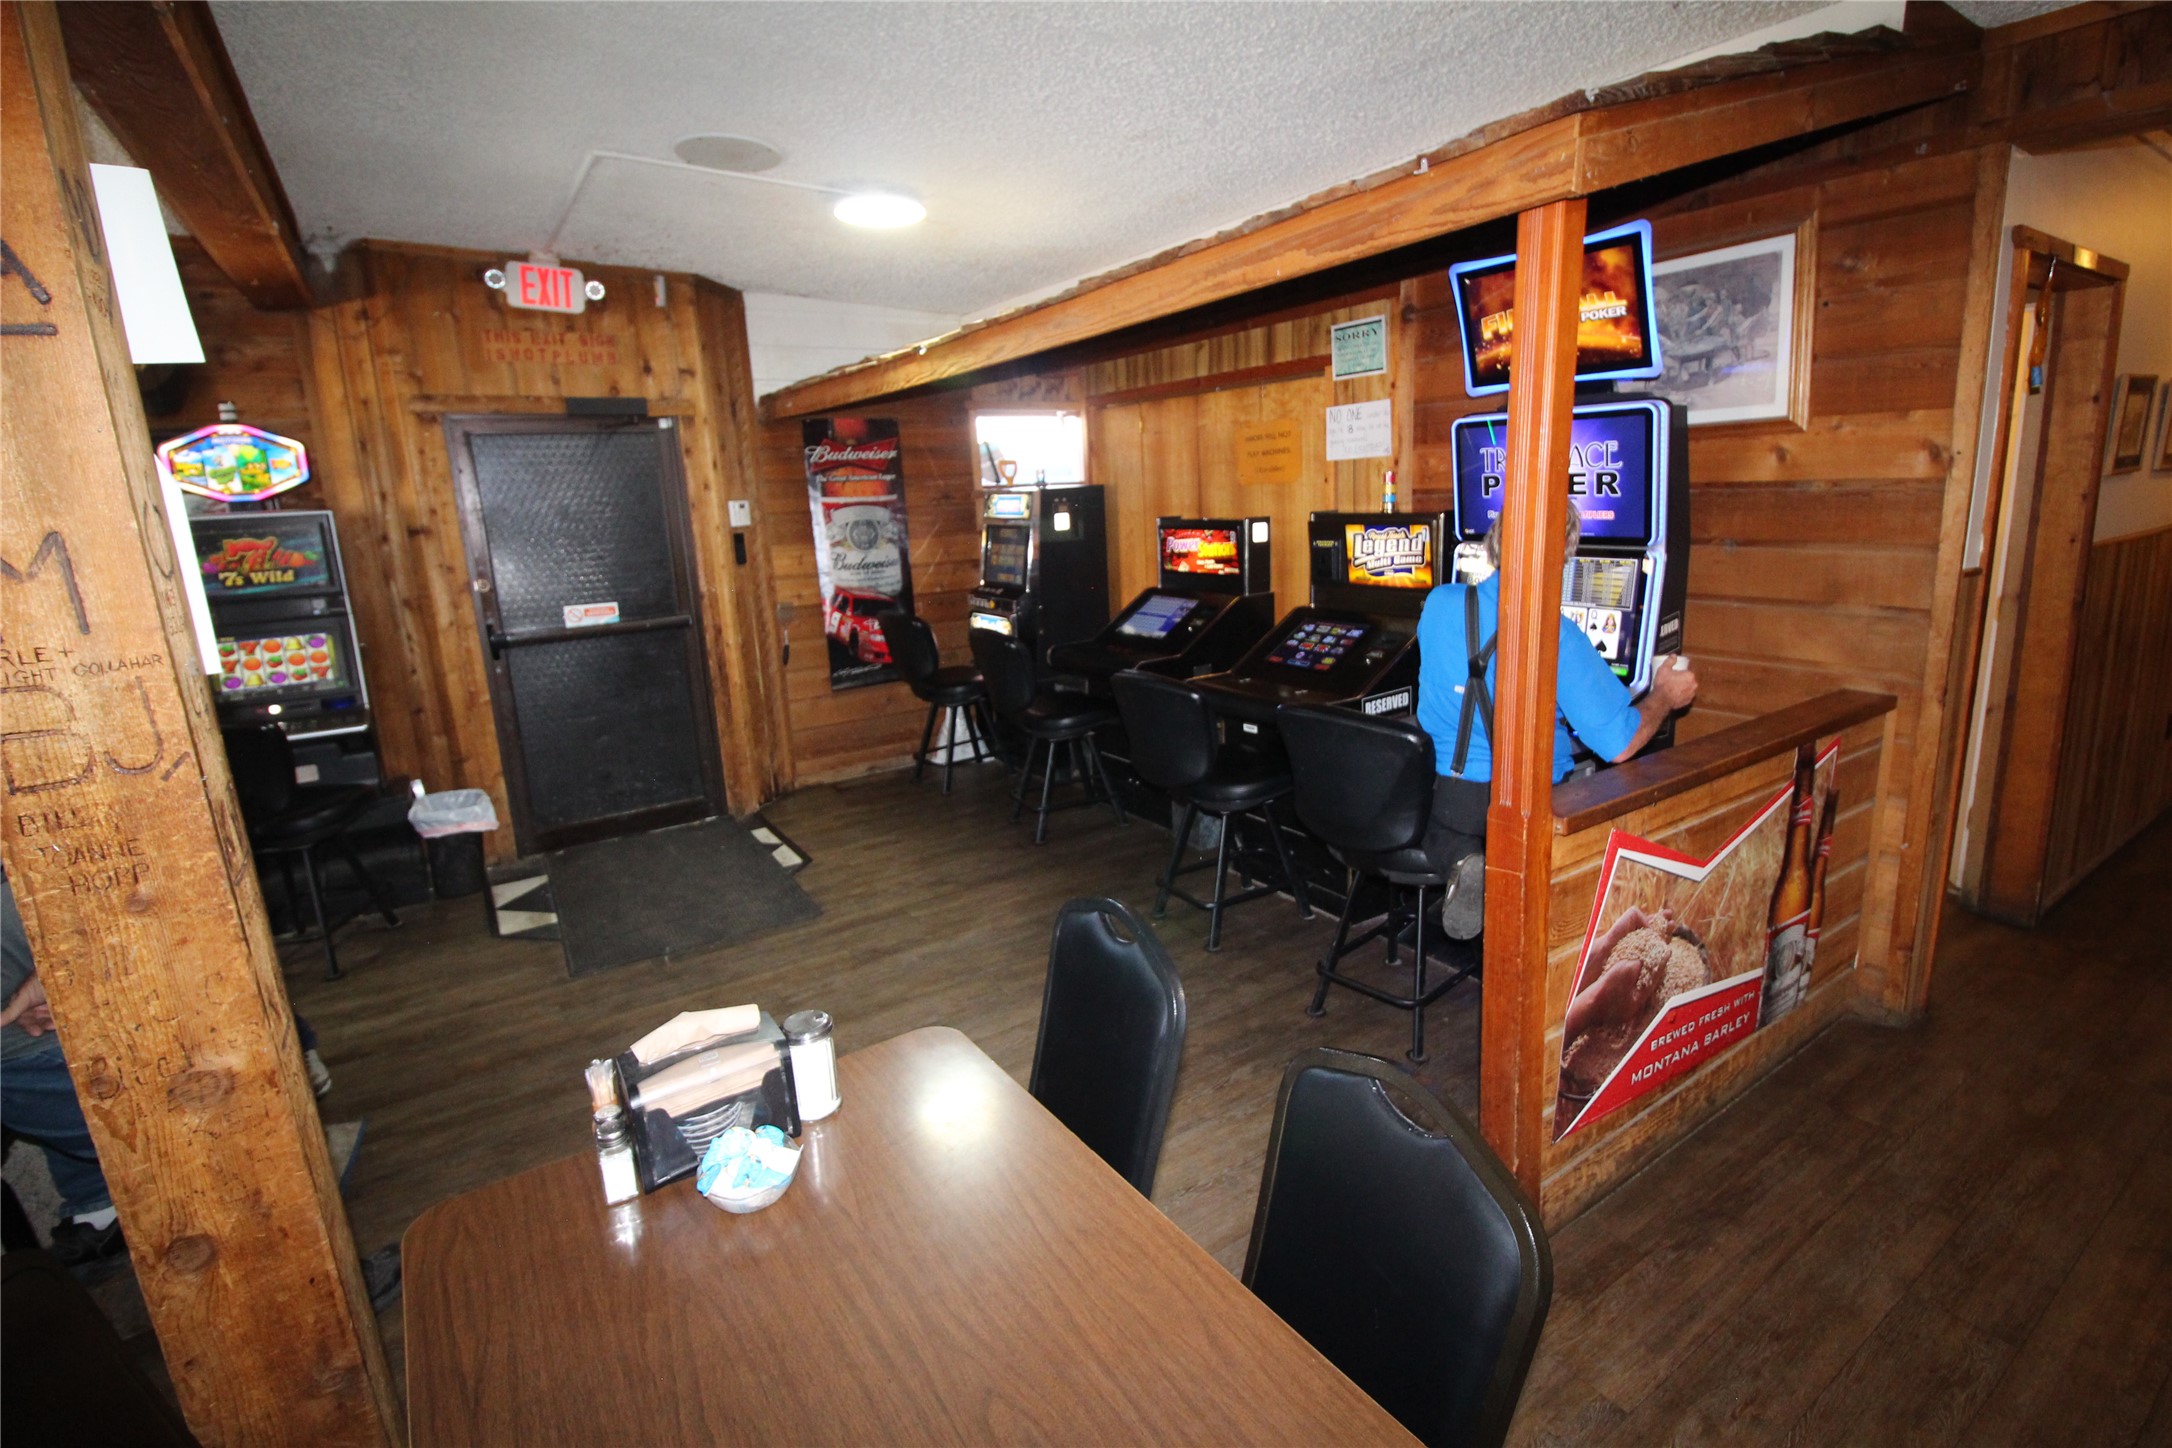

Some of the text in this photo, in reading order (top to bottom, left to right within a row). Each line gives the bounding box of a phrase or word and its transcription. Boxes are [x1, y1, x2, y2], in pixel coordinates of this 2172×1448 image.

[519, 264, 574, 309] EXIT
[1580, 305, 1627, 322] POKER
[1335, 327, 1378, 342] SORRY
[1329, 408, 1342, 424] NO
[1346, 406, 1362, 422] ONE
[1277, 430, 1291, 438] NOT
[805, 445, 898, 464] Budweiser
[1482, 471, 1621, 498] PER
[1354, 528, 1424, 558] Legend
[1366, 553, 1423, 571] Multi Game
[249, 569, 295, 585] Wild
[0, 667, 57, 686] IGHT
[1364, 692, 1410, 715] RESERVED
[67, 861, 151, 896] HOPP
[1650, 990, 1755, 1051] BREWED FRESH WITH
[1630, 1011, 1751, 1085] MONTANA BARLEY
